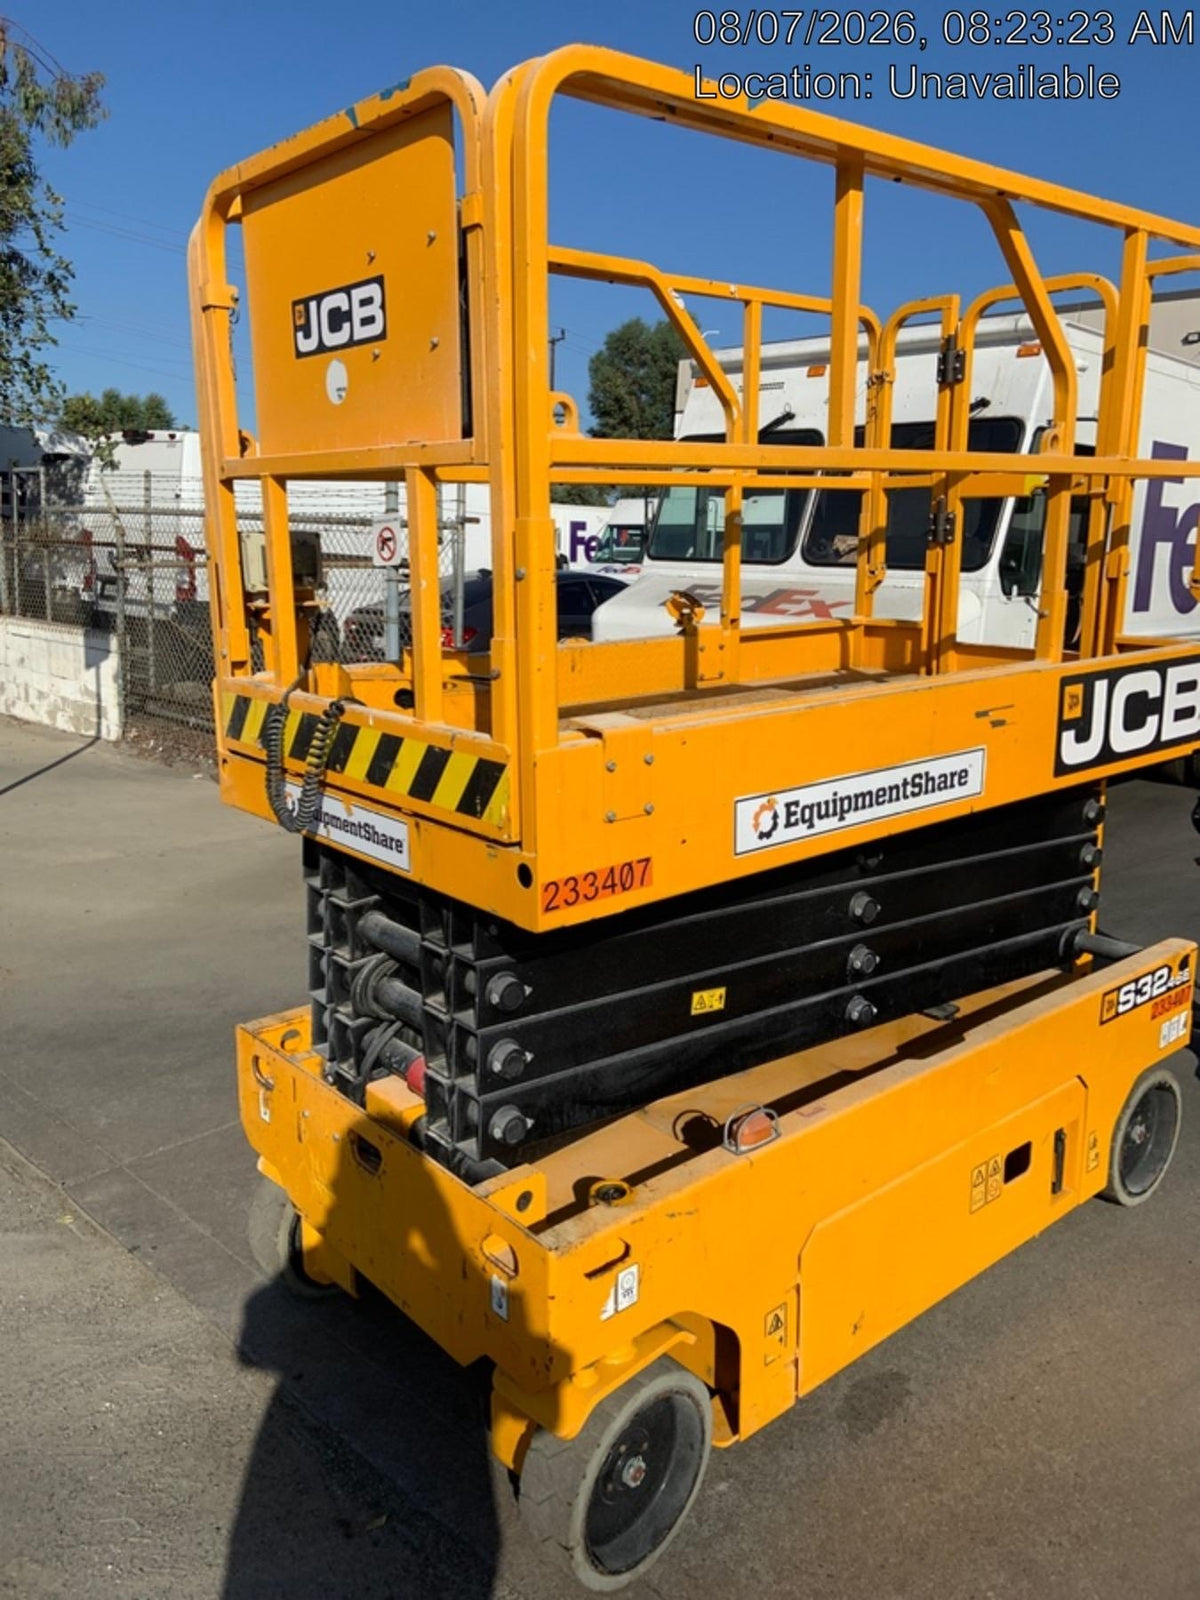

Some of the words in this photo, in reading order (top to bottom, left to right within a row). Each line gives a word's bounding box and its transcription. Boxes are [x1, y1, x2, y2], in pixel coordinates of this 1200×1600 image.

[296, 282, 385, 353] JCB
[1061, 662, 1200, 765] JCB
[783, 767, 970, 830] EquipmentShare
[543, 857, 652, 913] 233407
